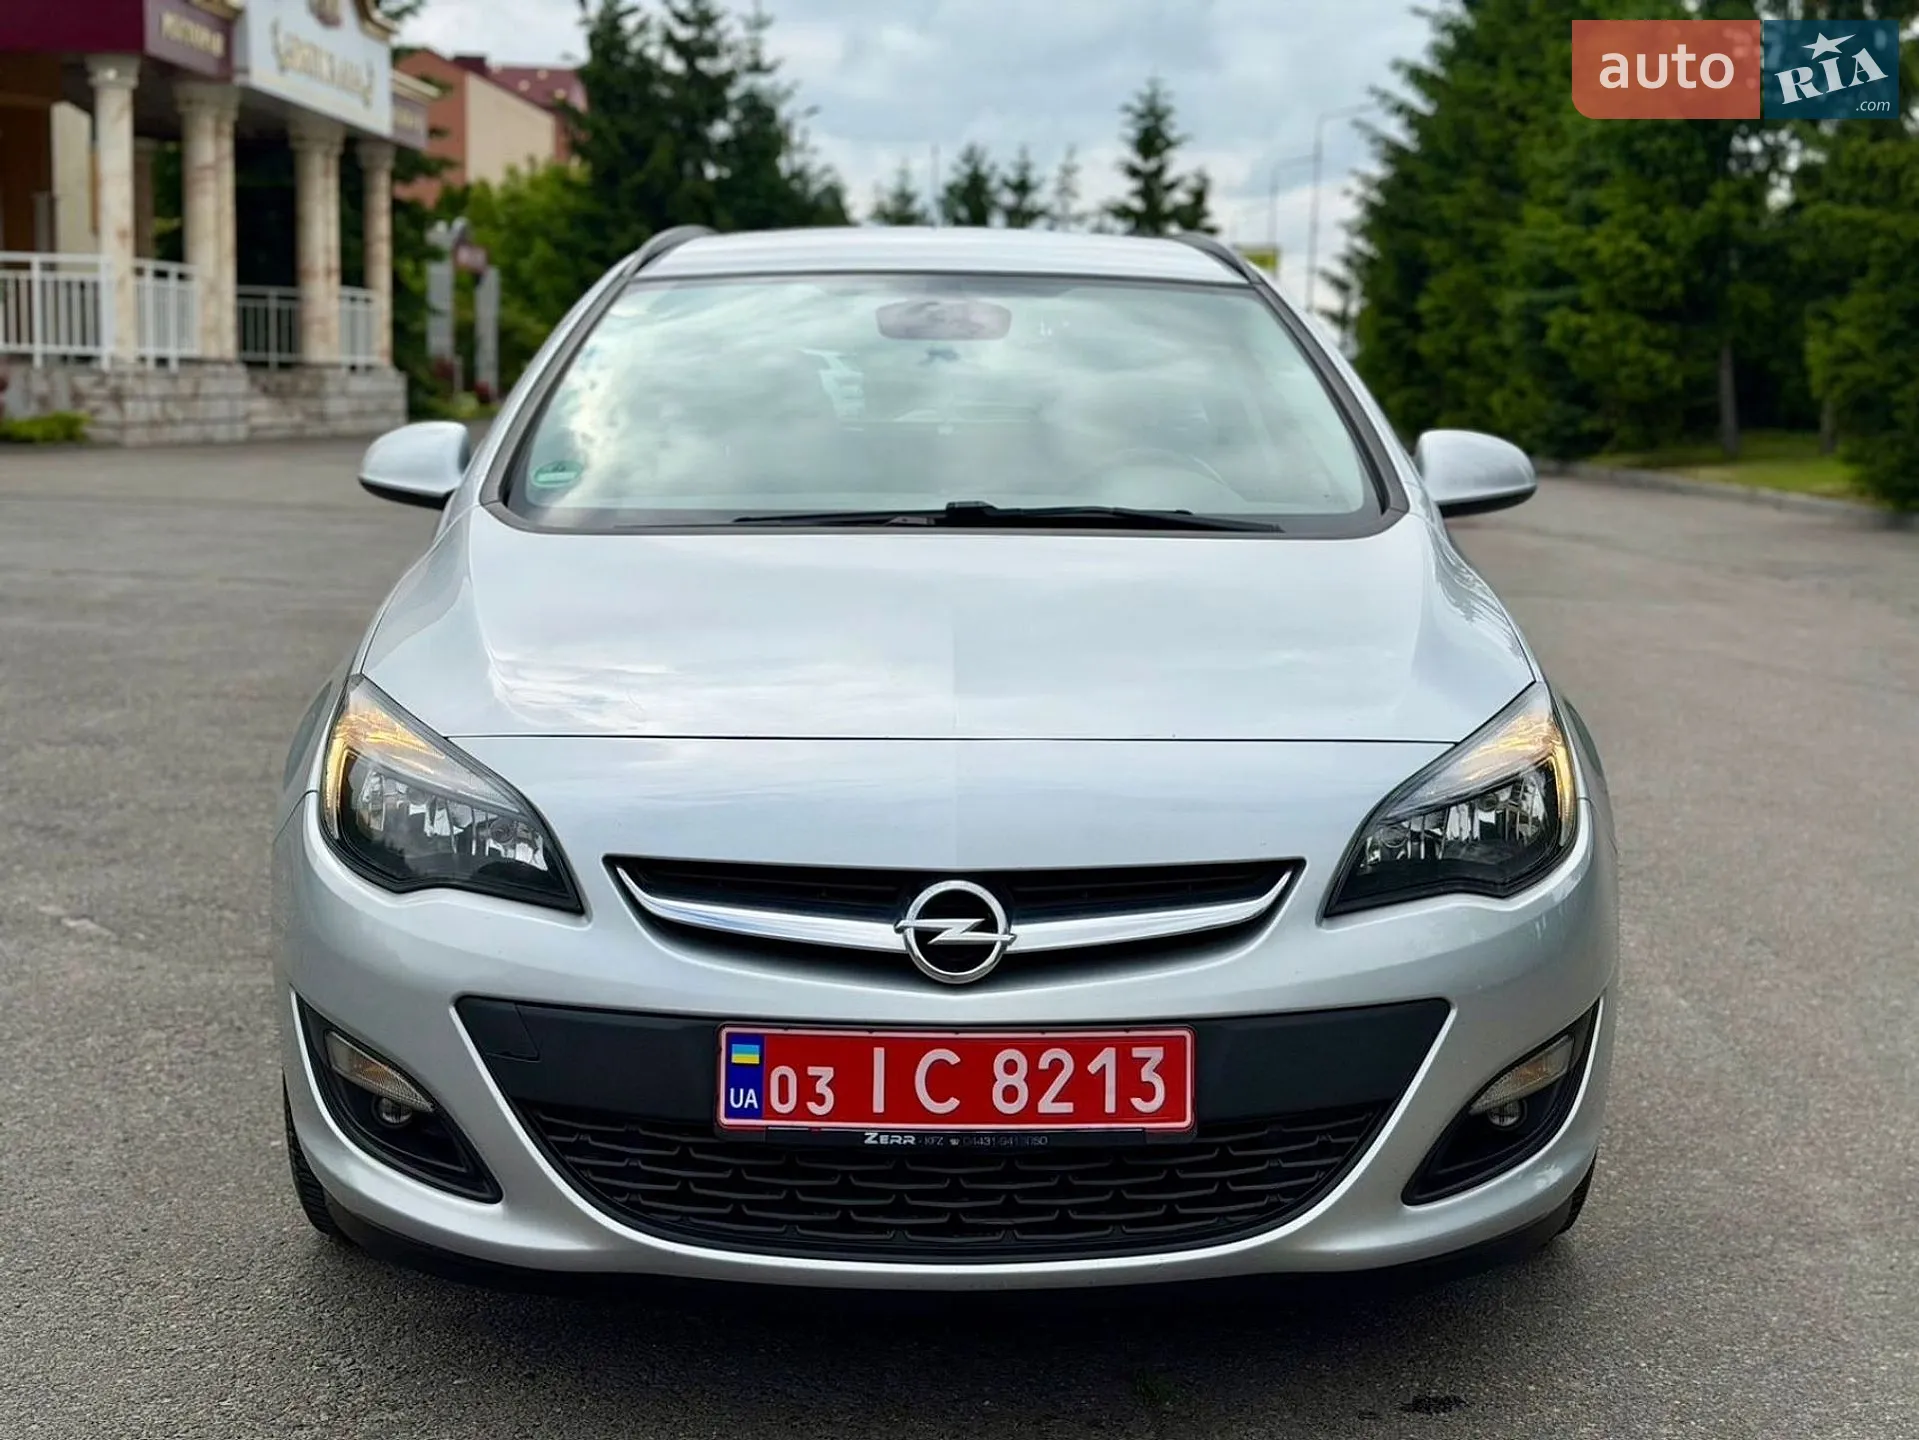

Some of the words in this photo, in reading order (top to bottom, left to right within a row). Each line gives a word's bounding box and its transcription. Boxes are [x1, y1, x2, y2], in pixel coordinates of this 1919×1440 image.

[729, 1087, 758, 1110] UA
[769, 1065, 835, 1116] 03
[991, 1045, 1165, 1115] 8213
